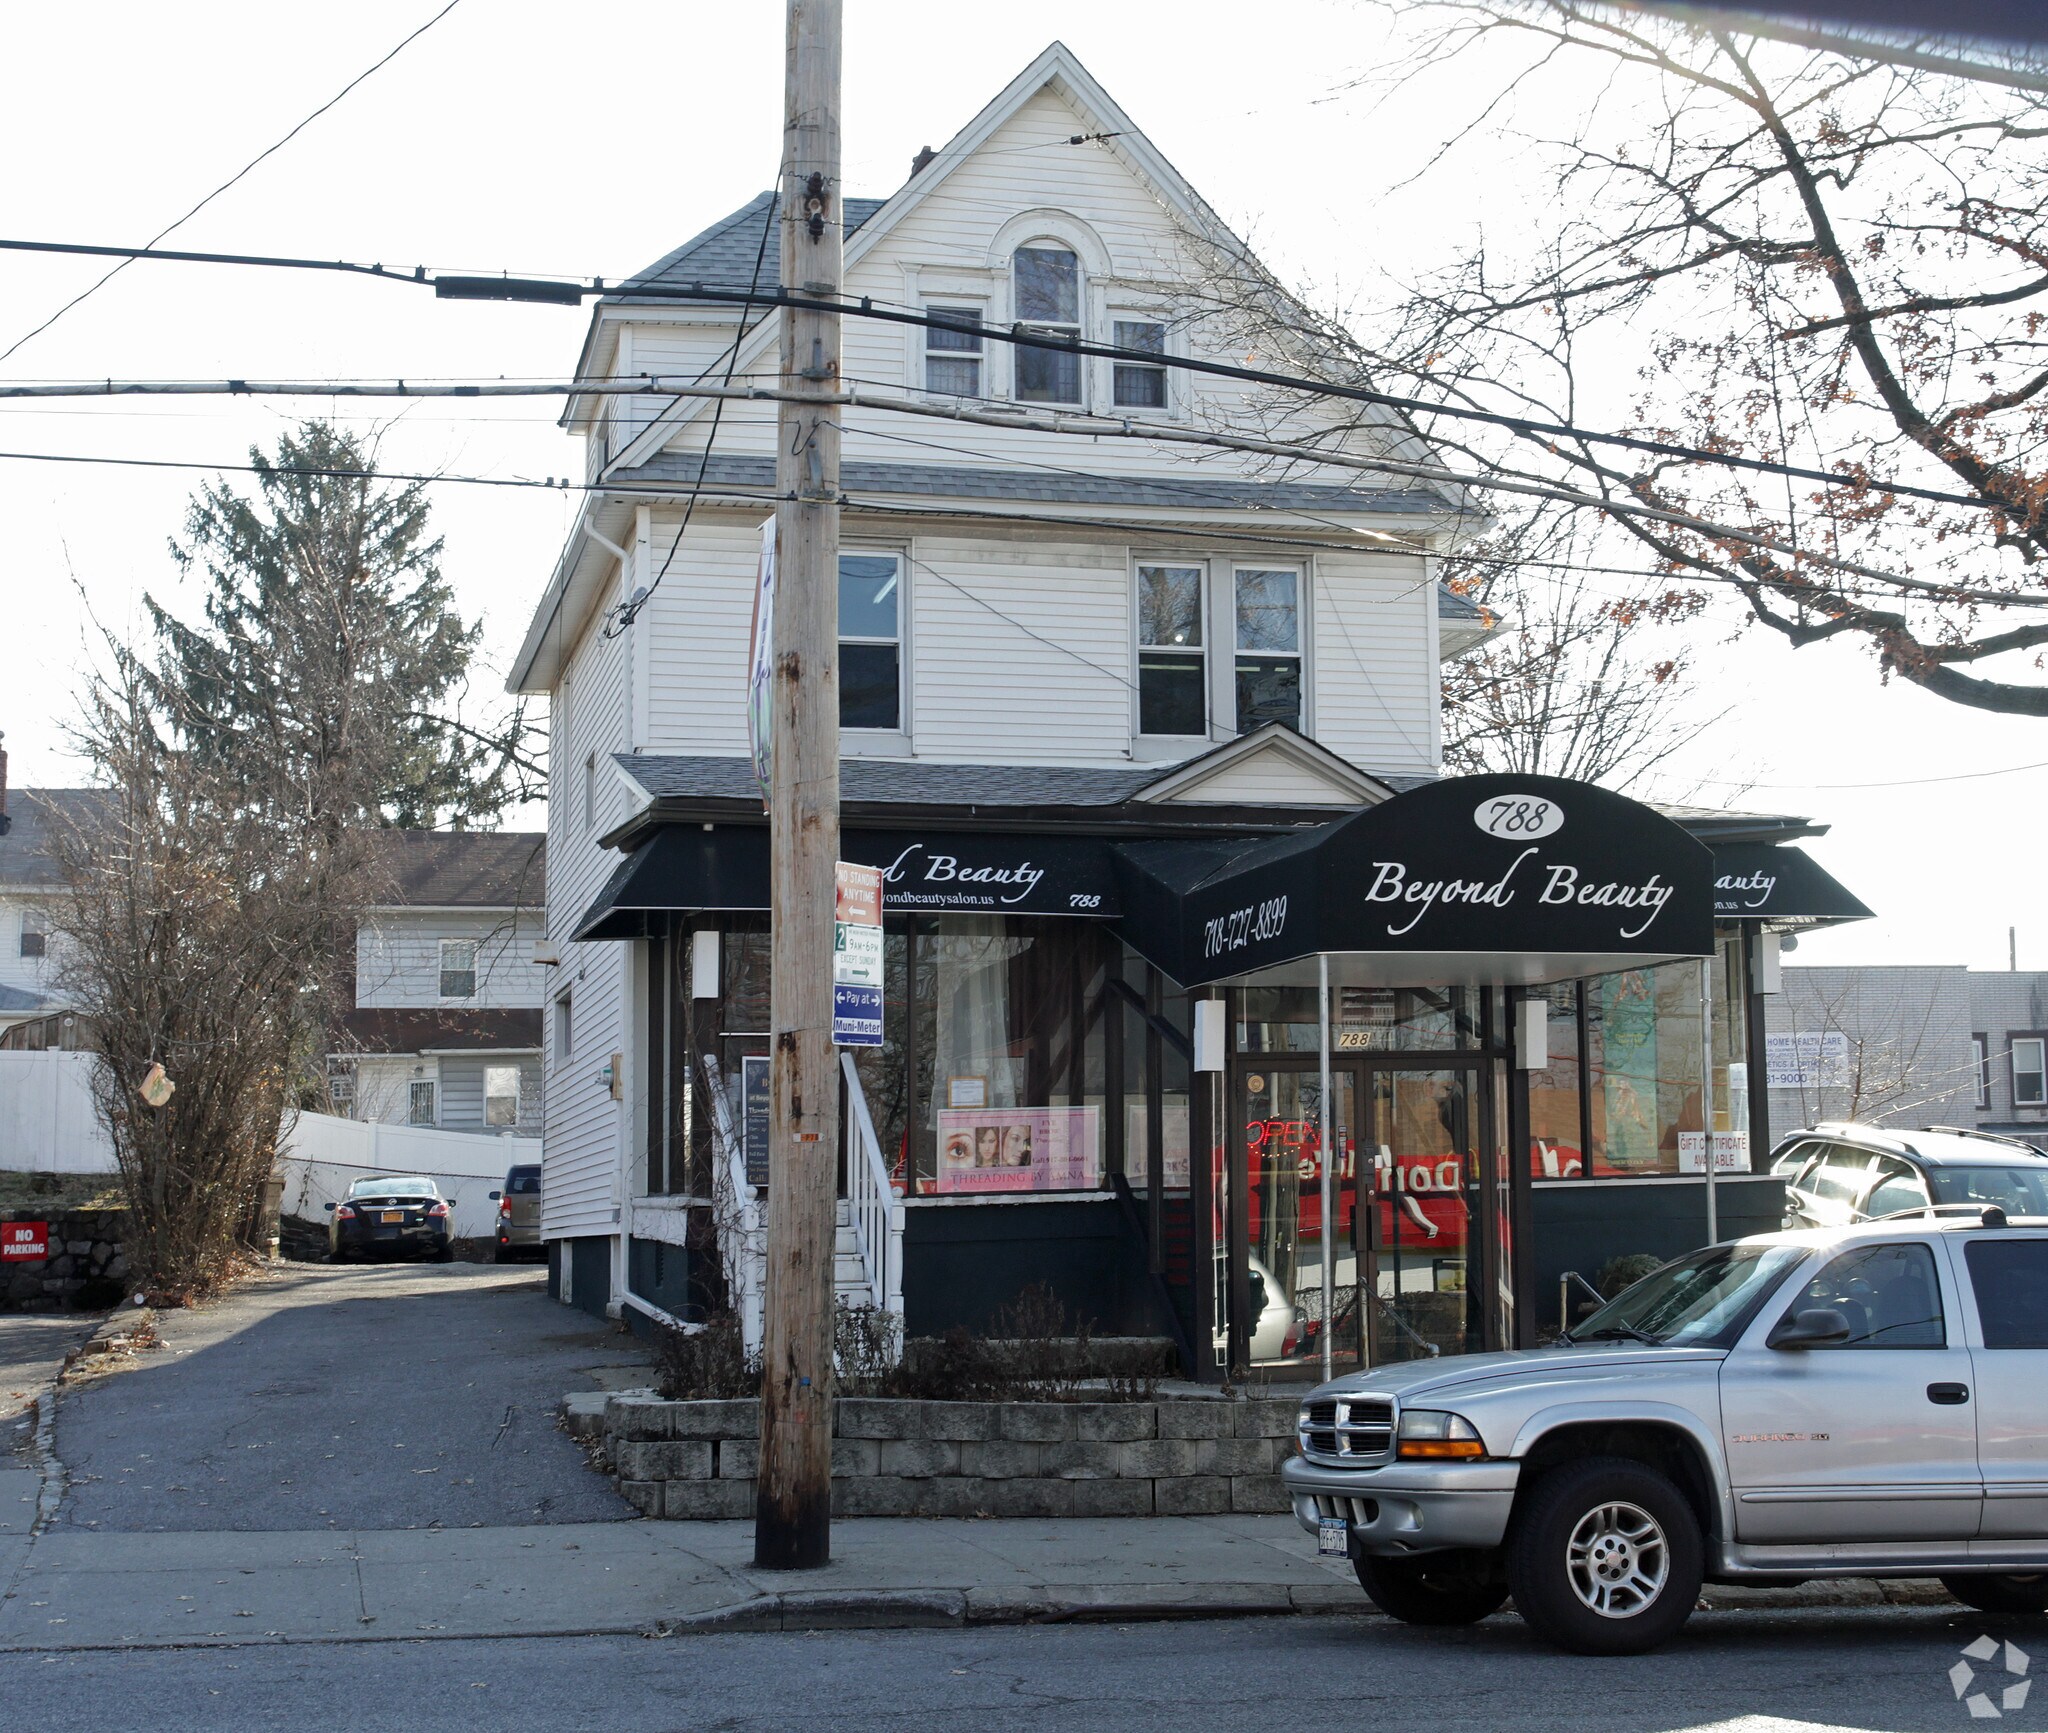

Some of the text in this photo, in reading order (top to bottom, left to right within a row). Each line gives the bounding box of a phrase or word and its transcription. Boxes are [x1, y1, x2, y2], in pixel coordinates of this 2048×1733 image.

[1489, 801, 1549, 832] 788
[838, 869, 880, 888] NO STANDING
[924, 855, 1044, 903] Beauty
[843, 887, 875, 904] ANYTIME
[1365, 847, 1674, 938] Beyond Beauty
[1069, 894, 1101, 908] 788
[1204, 895, 1287, 958] 718-727-8899
[837, 927, 846, 950] 2
[840, 953, 877, 966] EXCEPT SUNDAY
[846, 990, 870, 1007] Pay at
[835, 1019, 880, 1034] Muni-Meter
[1341, 1033, 1369, 1046] 788
[1767, 1037, 1790, 1046] HOME
[1822, 1036, 1842, 1045] CARE
[1245, 1120, 1322, 1146] OPEN
[1680, 1137, 1746, 1150] GIFT CTIFICATE
[1694, 1154, 1735, 1167] AVAABLE
[950, 1170, 1085, 1185] THREADING BY AMNA
[15, 1229, 34, 1242] NO
[3, 1243, 45, 1255] PARKING
